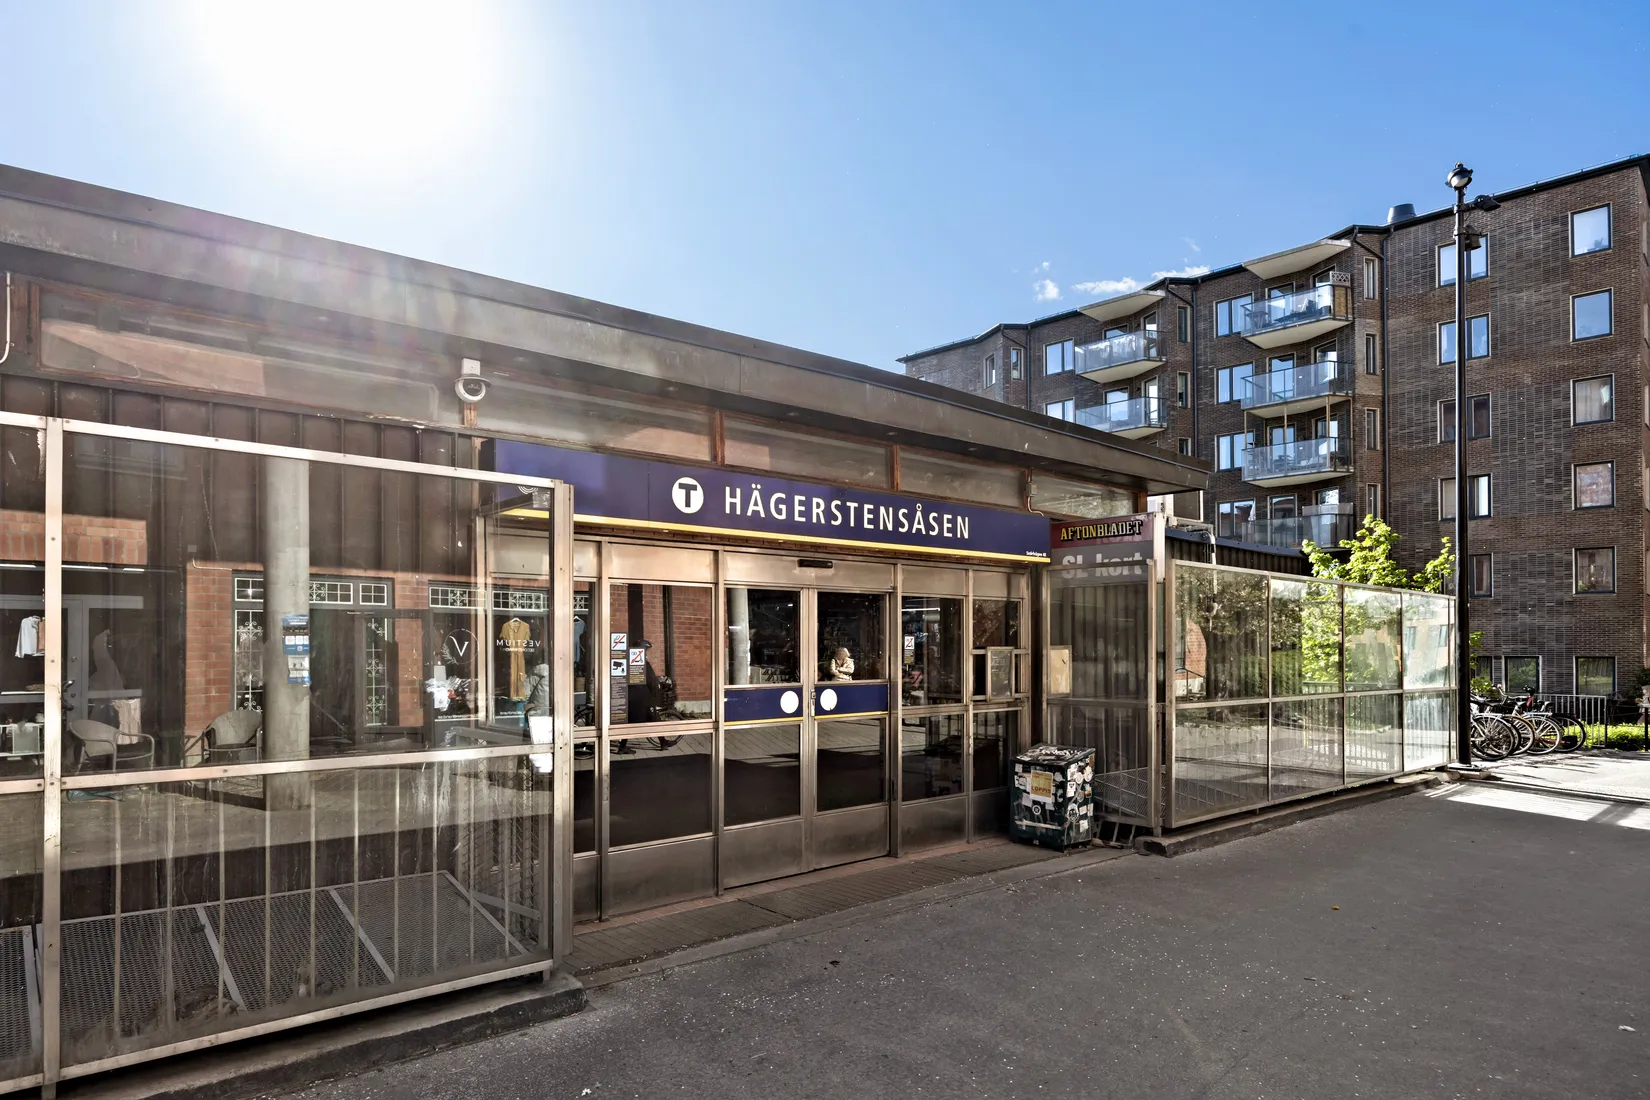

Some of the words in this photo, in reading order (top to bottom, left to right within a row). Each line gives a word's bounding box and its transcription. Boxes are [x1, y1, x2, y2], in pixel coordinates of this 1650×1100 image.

[678, 482, 698, 508] T
[725, 483, 969, 540] HÄGERSTENSÅSEN
[1060, 520, 1142, 541] AFTONBLADET
[1031, 785, 1052, 794] LOPPIS
